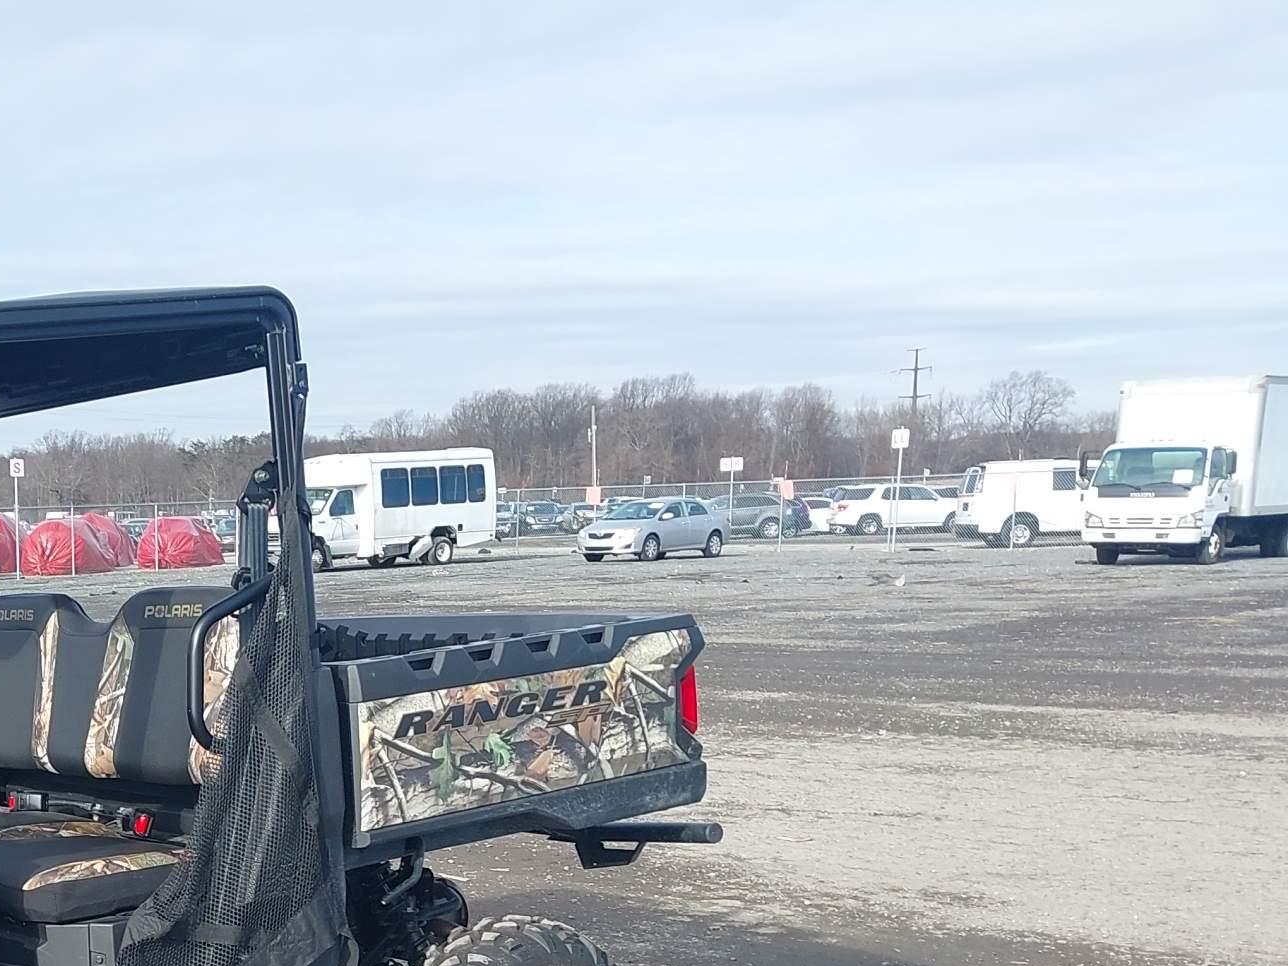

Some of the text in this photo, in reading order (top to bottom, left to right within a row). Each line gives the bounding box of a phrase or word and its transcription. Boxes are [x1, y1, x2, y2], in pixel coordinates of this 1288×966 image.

[14, 462, 21, 474] S
[144, 604, 202, 618] POLARIS
[393, 680, 607, 739] RANGER
